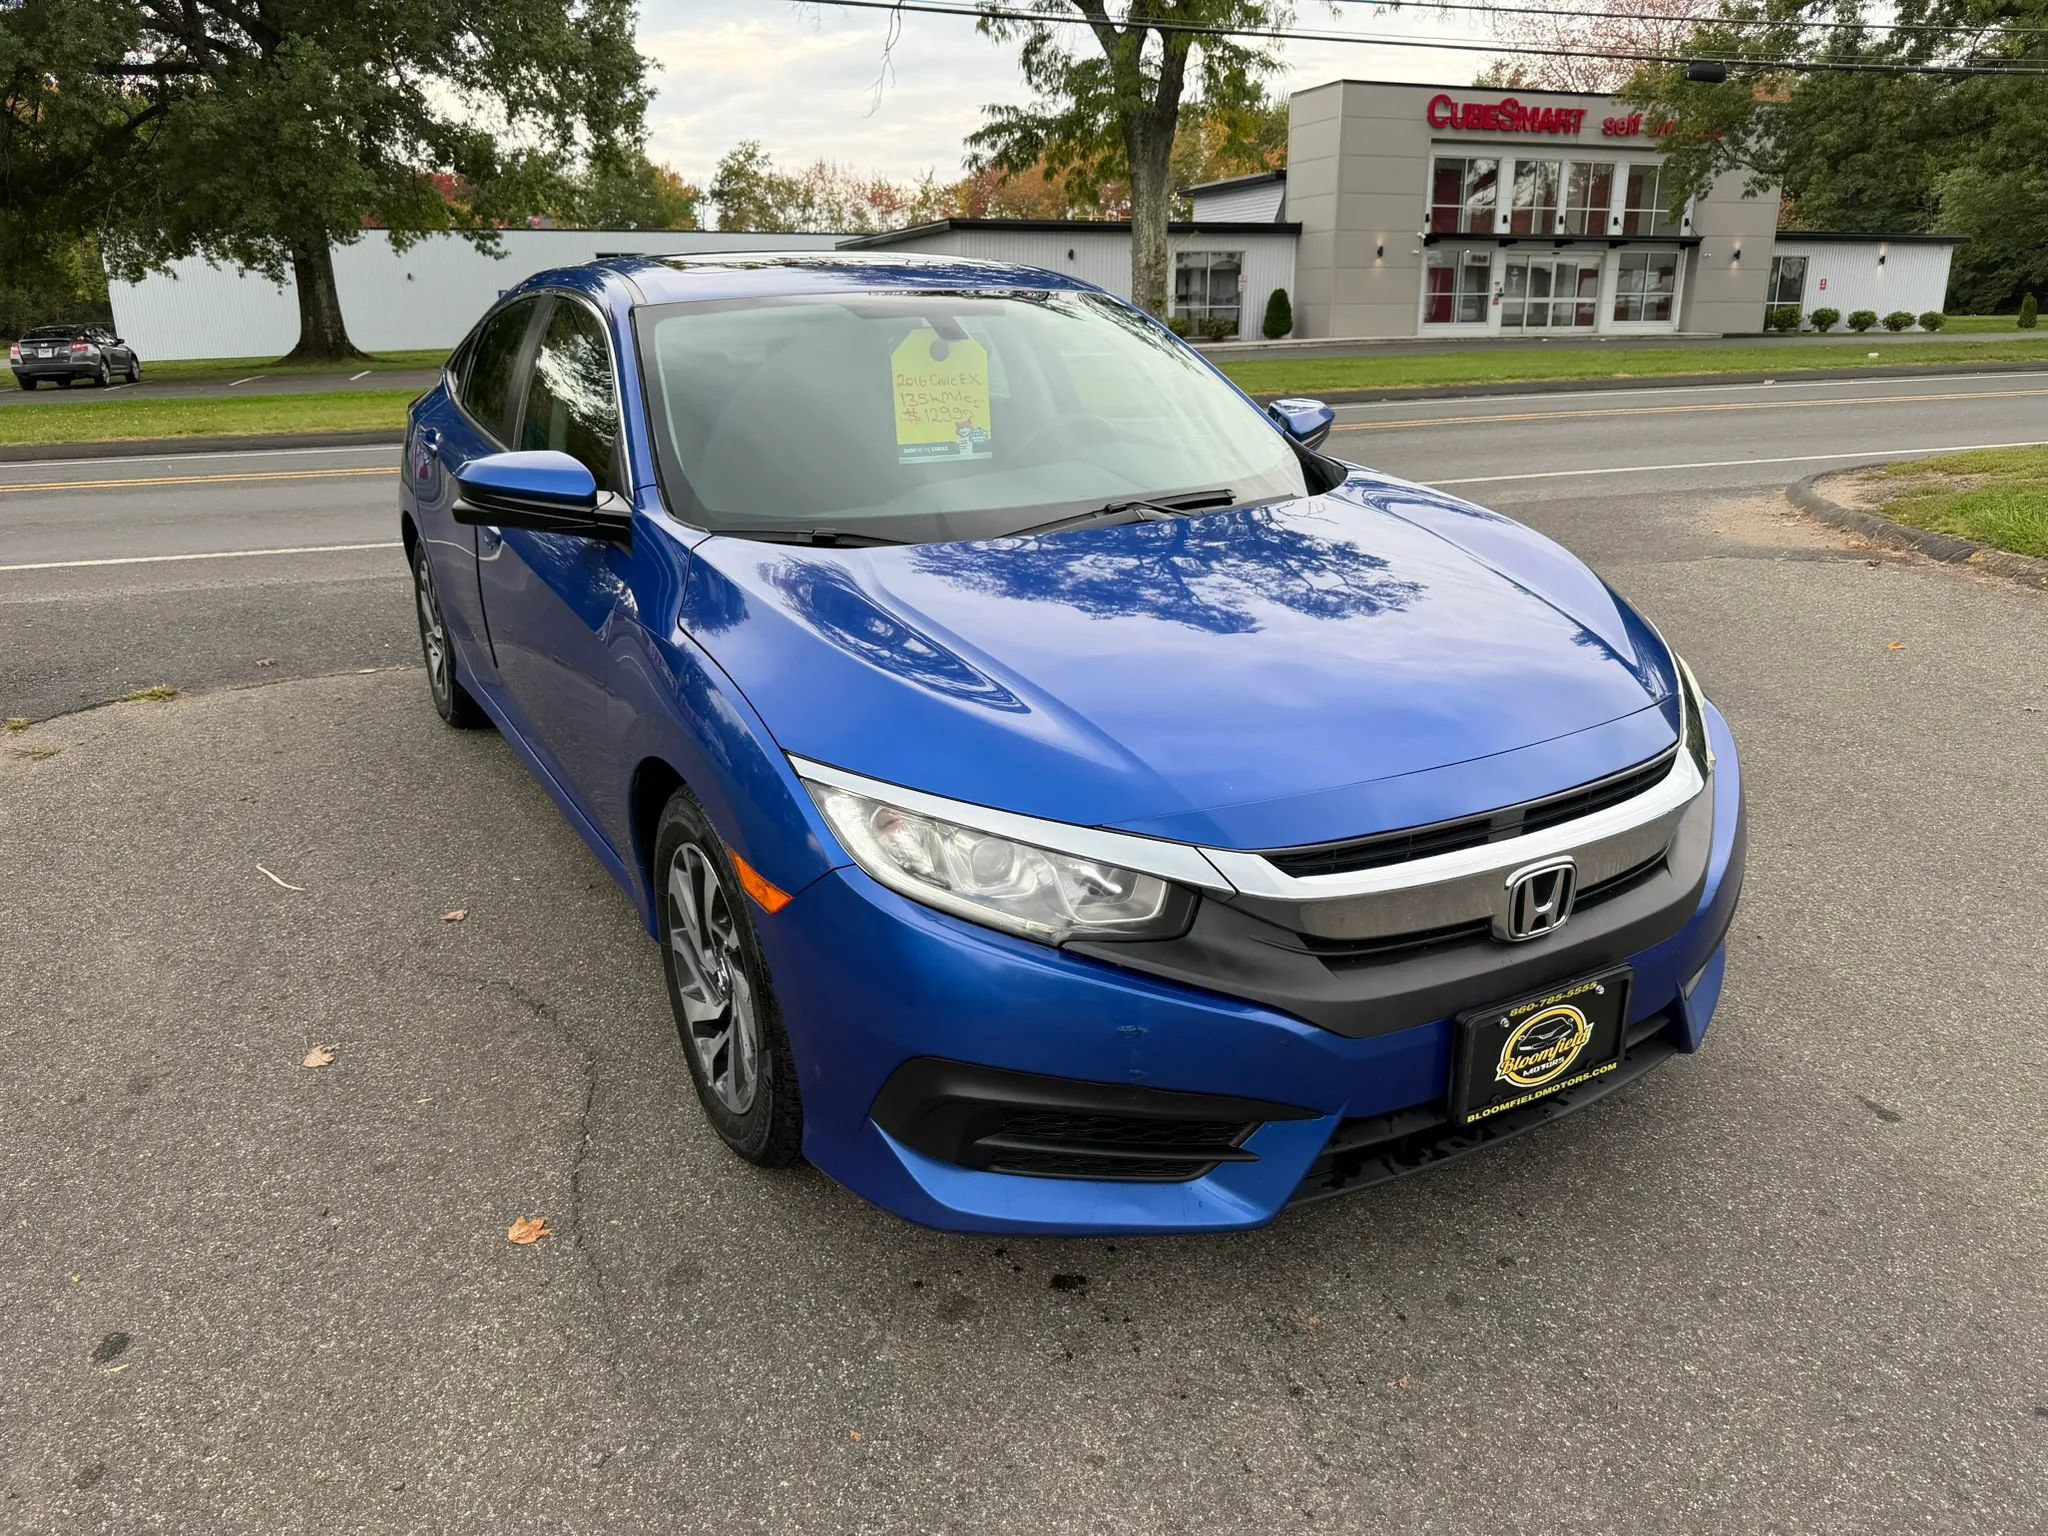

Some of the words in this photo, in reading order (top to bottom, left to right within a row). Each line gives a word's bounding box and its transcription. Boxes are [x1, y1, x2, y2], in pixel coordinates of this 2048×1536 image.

[1602, 113, 1643, 136] self
[897, 373, 928, 388] 2016
[930, 373, 957, 386] Civic
[959, 372, 981, 386] EX
[902, 406, 922, 424] $
[1509, 981, 1598, 1017] 860-785-5555
[1500, 1027, 1589, 1075] Bloomfield
[1522, 1056, 1566, 1077] MOTORS
[1466, 1062, 1618, 1124] BLOOMFIELDMOTORS.COM
